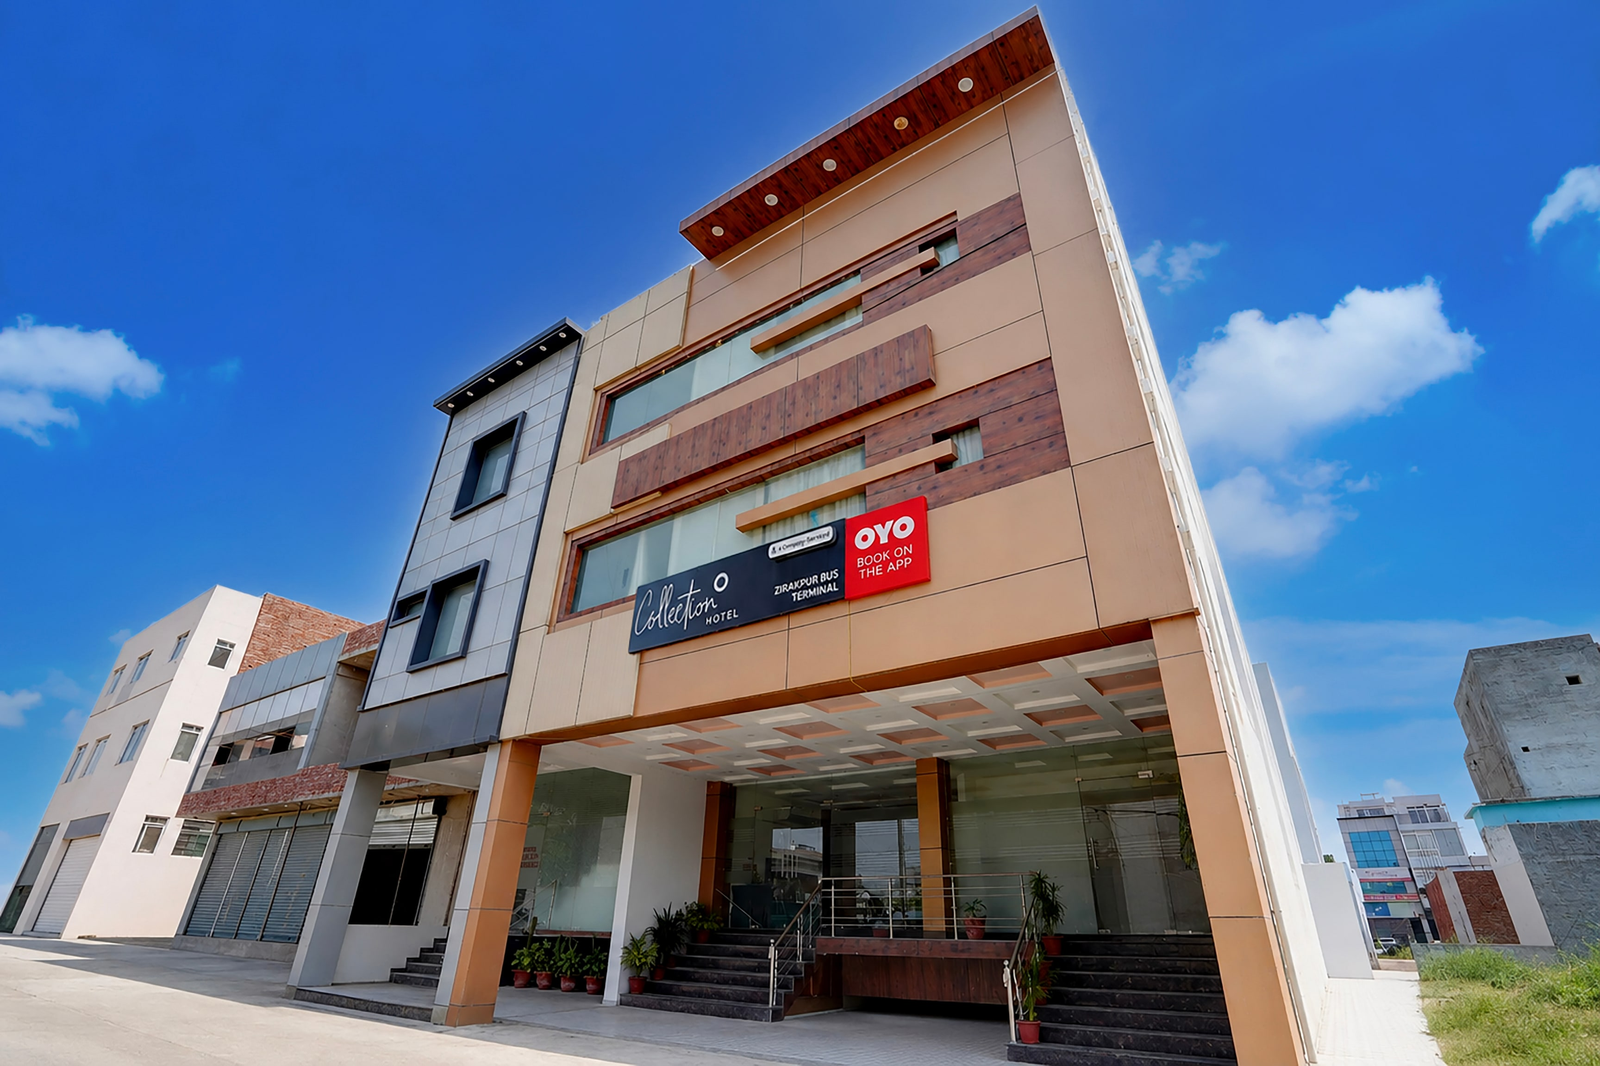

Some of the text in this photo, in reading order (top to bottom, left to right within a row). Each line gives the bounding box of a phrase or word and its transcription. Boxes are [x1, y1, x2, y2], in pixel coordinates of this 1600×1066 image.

[854, 515, 915, 550] OYO
[857, 543, 913, 568] BOOK ON
[858, 557, 912, 579] THE APP
[774, 568, 839, 596] ZIRAKPUR BUS
[791, 582, 839, 602] TERMINAL
[634, 579, 718, 636] Collection
[705, 608, 739, 626] HOTEL
